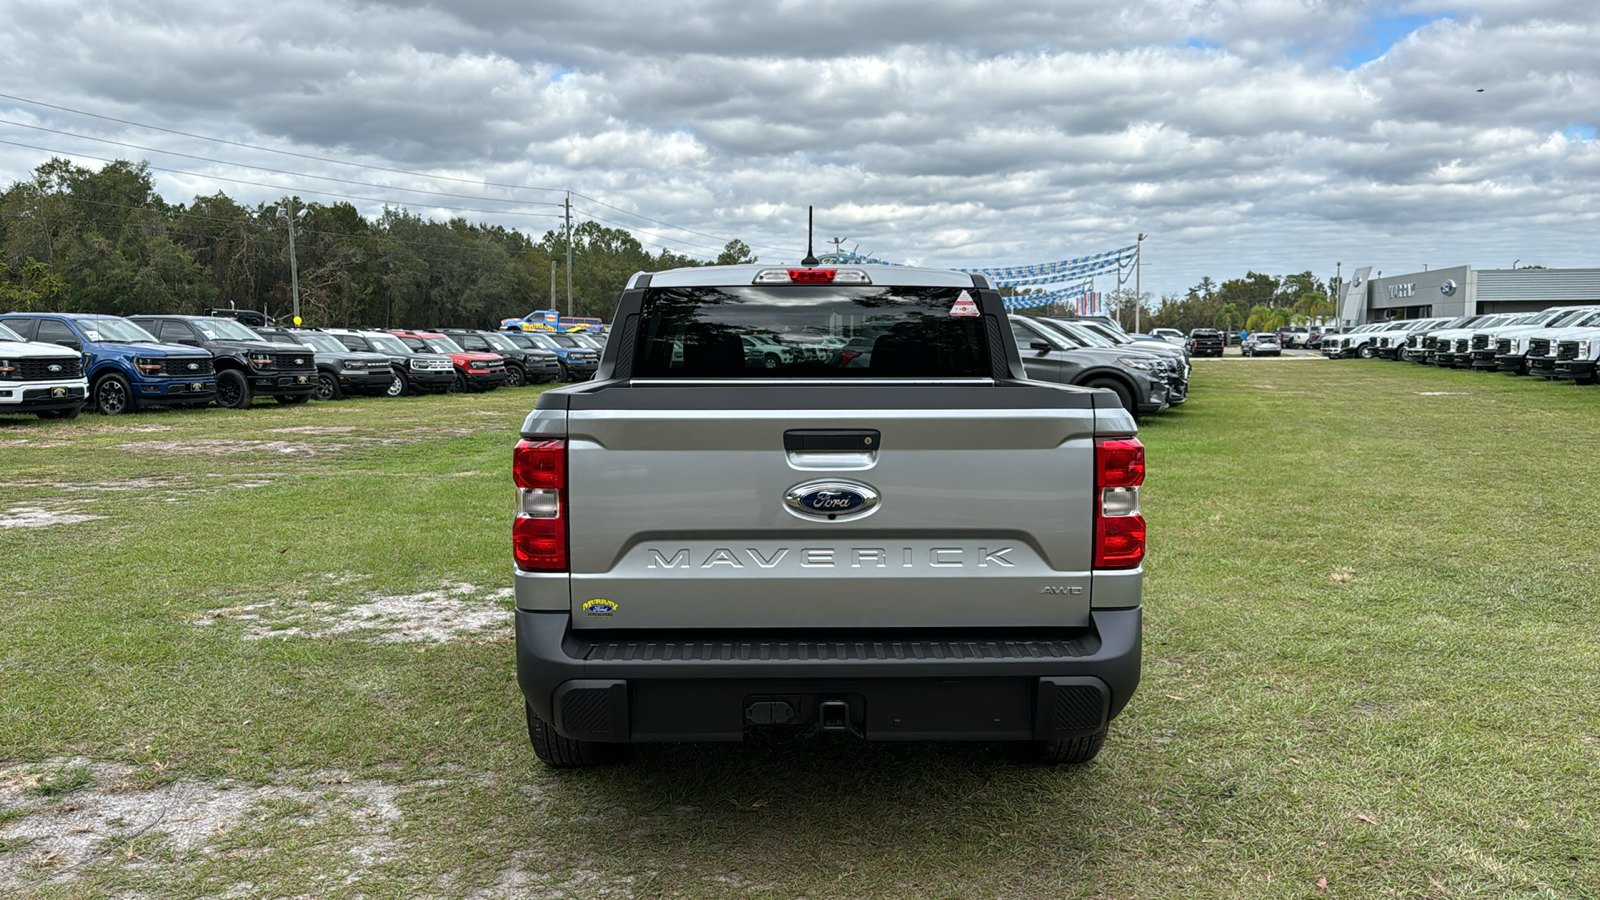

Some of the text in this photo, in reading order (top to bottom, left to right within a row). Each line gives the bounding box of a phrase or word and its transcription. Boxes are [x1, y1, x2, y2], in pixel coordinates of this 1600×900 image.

[813, 491, 852, 508] Ford
[647, 547, 1015, 569] MAVERICK
[1040, 586, 1083, 595] AWD
[582, 599, 618, 611] MURRAY
